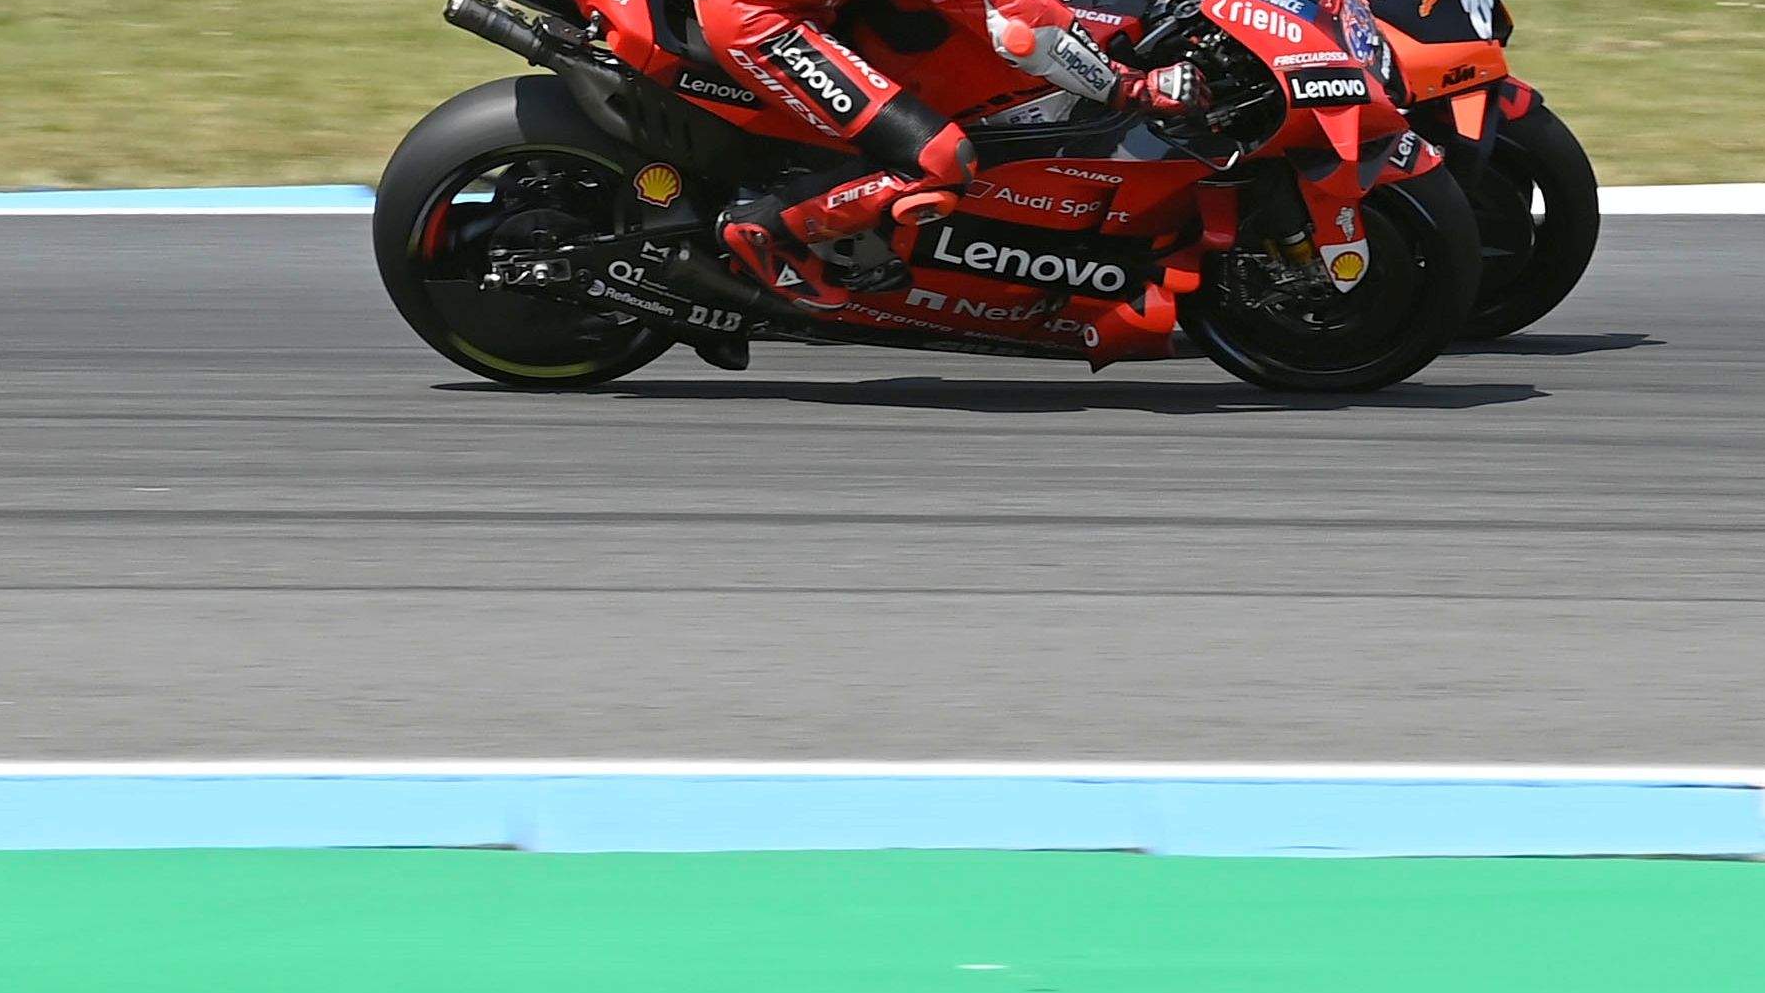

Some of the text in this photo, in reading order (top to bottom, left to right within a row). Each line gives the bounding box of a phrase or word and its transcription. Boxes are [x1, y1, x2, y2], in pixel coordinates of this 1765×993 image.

[770, 27, 853, 113] Lenovo
[1442, 64, 1476, 88] KTM
[679, 72, 755, 103] Lenovo
[1291, 78, 1366, 100] Lenovo
[1063, 168, 1124, 185] DAIKO
[994, 187, 1054, 212] Audi
[933, 226, 1127, 293] Lenovo
